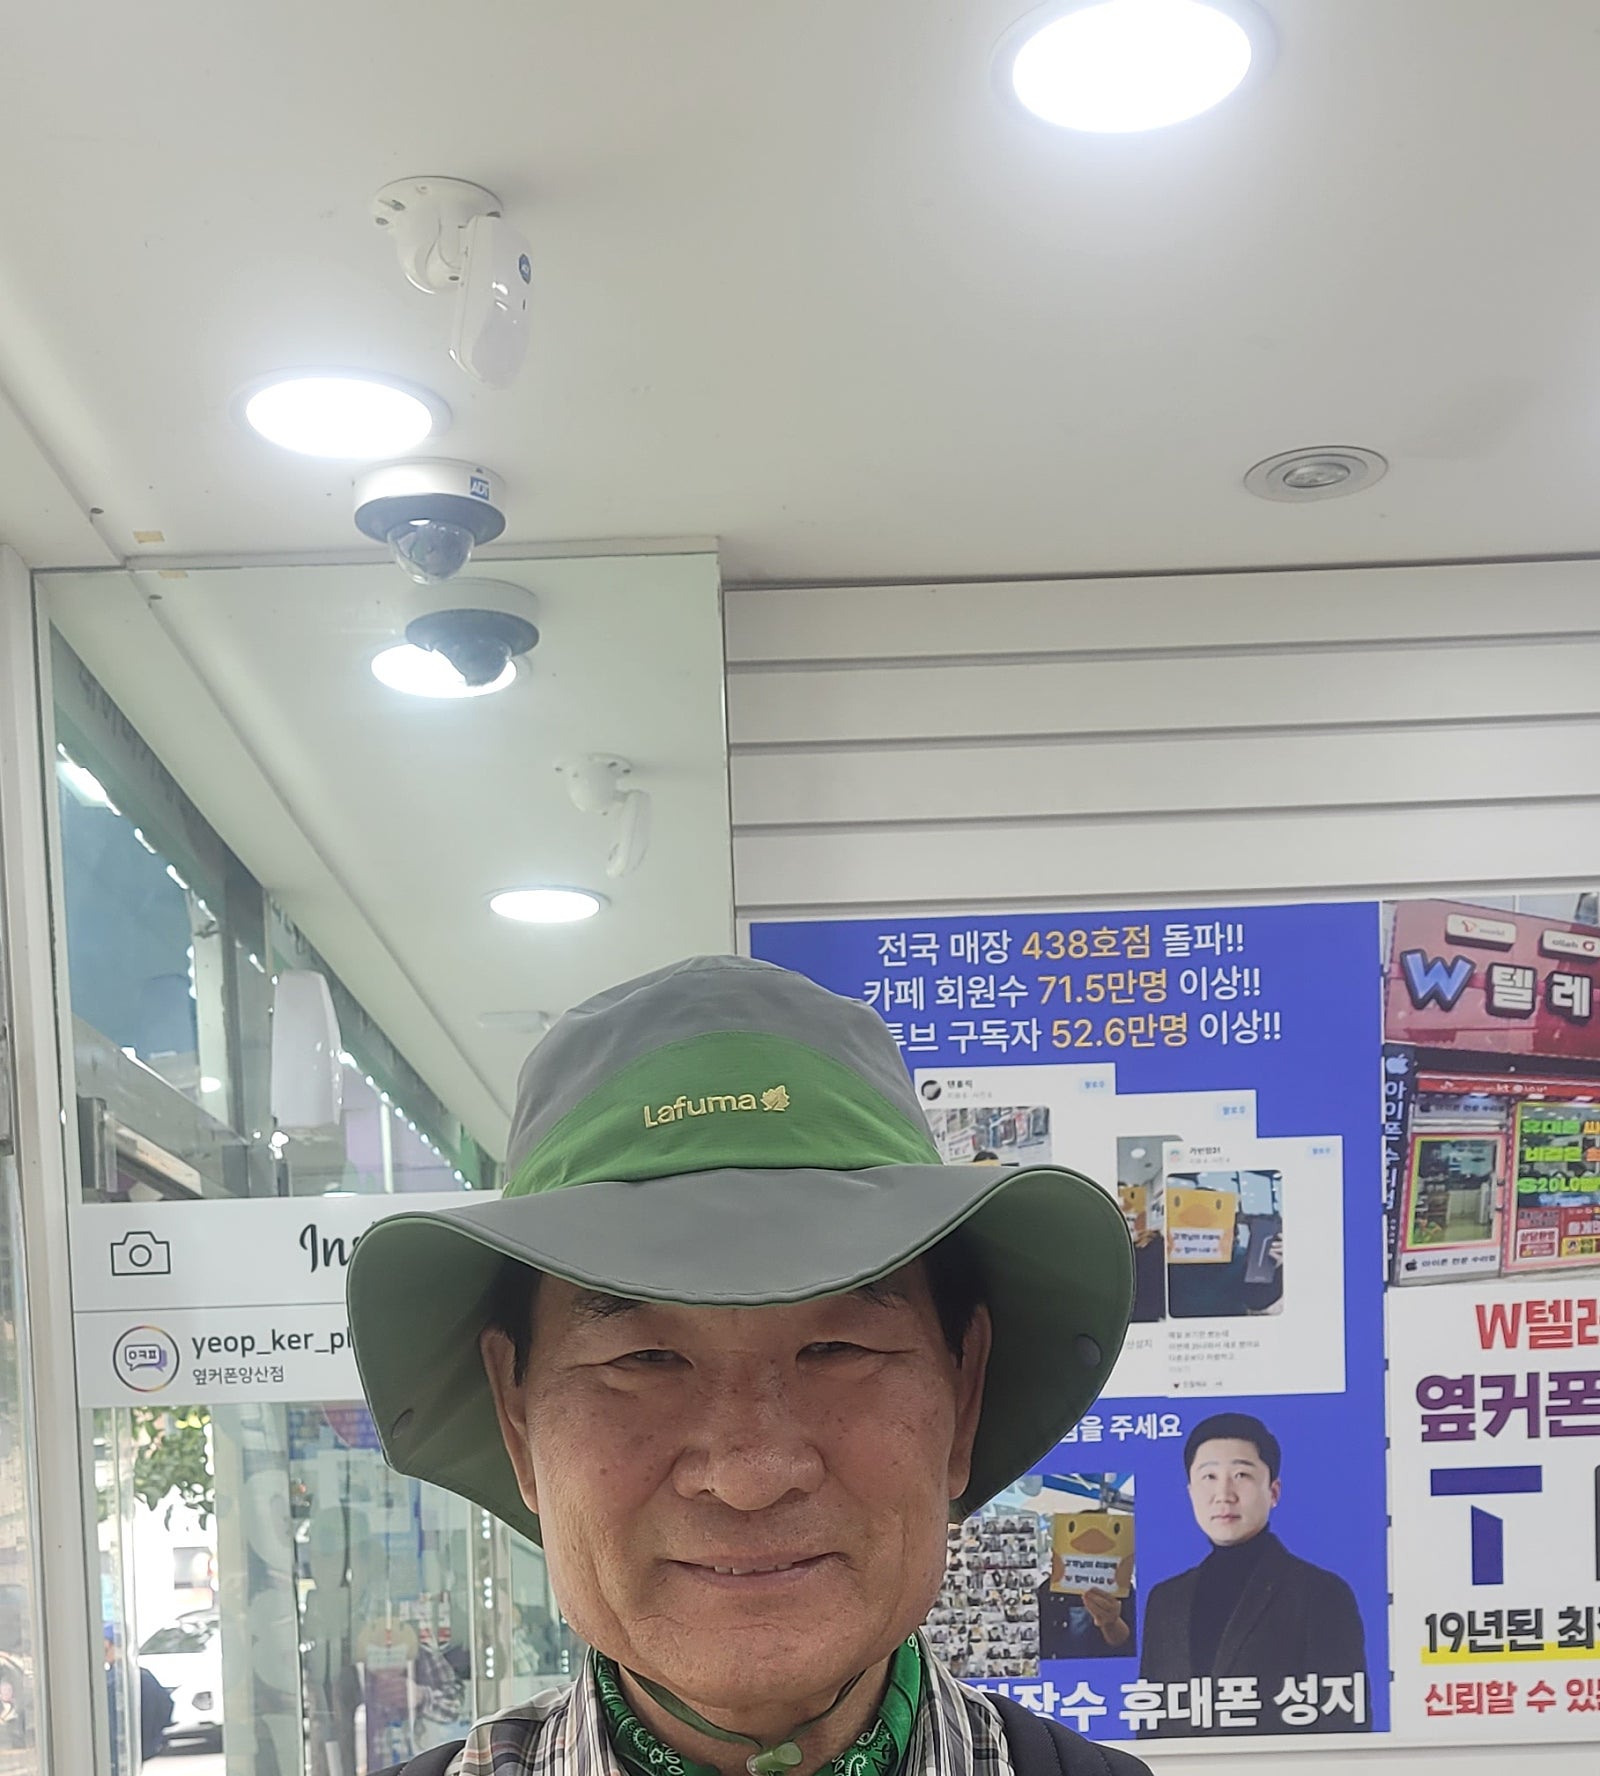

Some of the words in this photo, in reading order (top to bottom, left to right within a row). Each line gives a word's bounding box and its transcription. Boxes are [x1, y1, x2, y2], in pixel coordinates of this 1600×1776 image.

[877, 931, 940, 967] 전국
[950, 930, 1011, 964] 매장
[1022, 925, 1151, 960] 438호점
[1162, 922, 1245, 957] 돌파!!
[863, 978, 925, 1012] 카페
[935, 974, 1029, 1010] 회원수
[1037, 968, 1168, 1005] 71.5만명
[1179, 965, 1261, 1000] 이상!!
[947, 1017, 1041, 1054] 구독자
[1051, 1012, 1188, 1049] 52.6만명
[1199, 1010, 1282, 1046] 이상!!
[643, 1093, 757, 1129] Lafuma
[299, 1223, 360, 1273] In
[1109, 1413, 1183, 1442] 주세요
[1425, 1607, 1544, 1654] 19년된
[1558, 1605, 1600, 1650] 최
[1119, 1676, 1263, 1732] 휴대폰
[1273, 1671, 1366, 1726] 성지
[1425, 1680, 1518, 1717] 신뢰할
[1527, 1680, 1556, 1714] 수
[1567, 1677, 1600, 1713] 있
